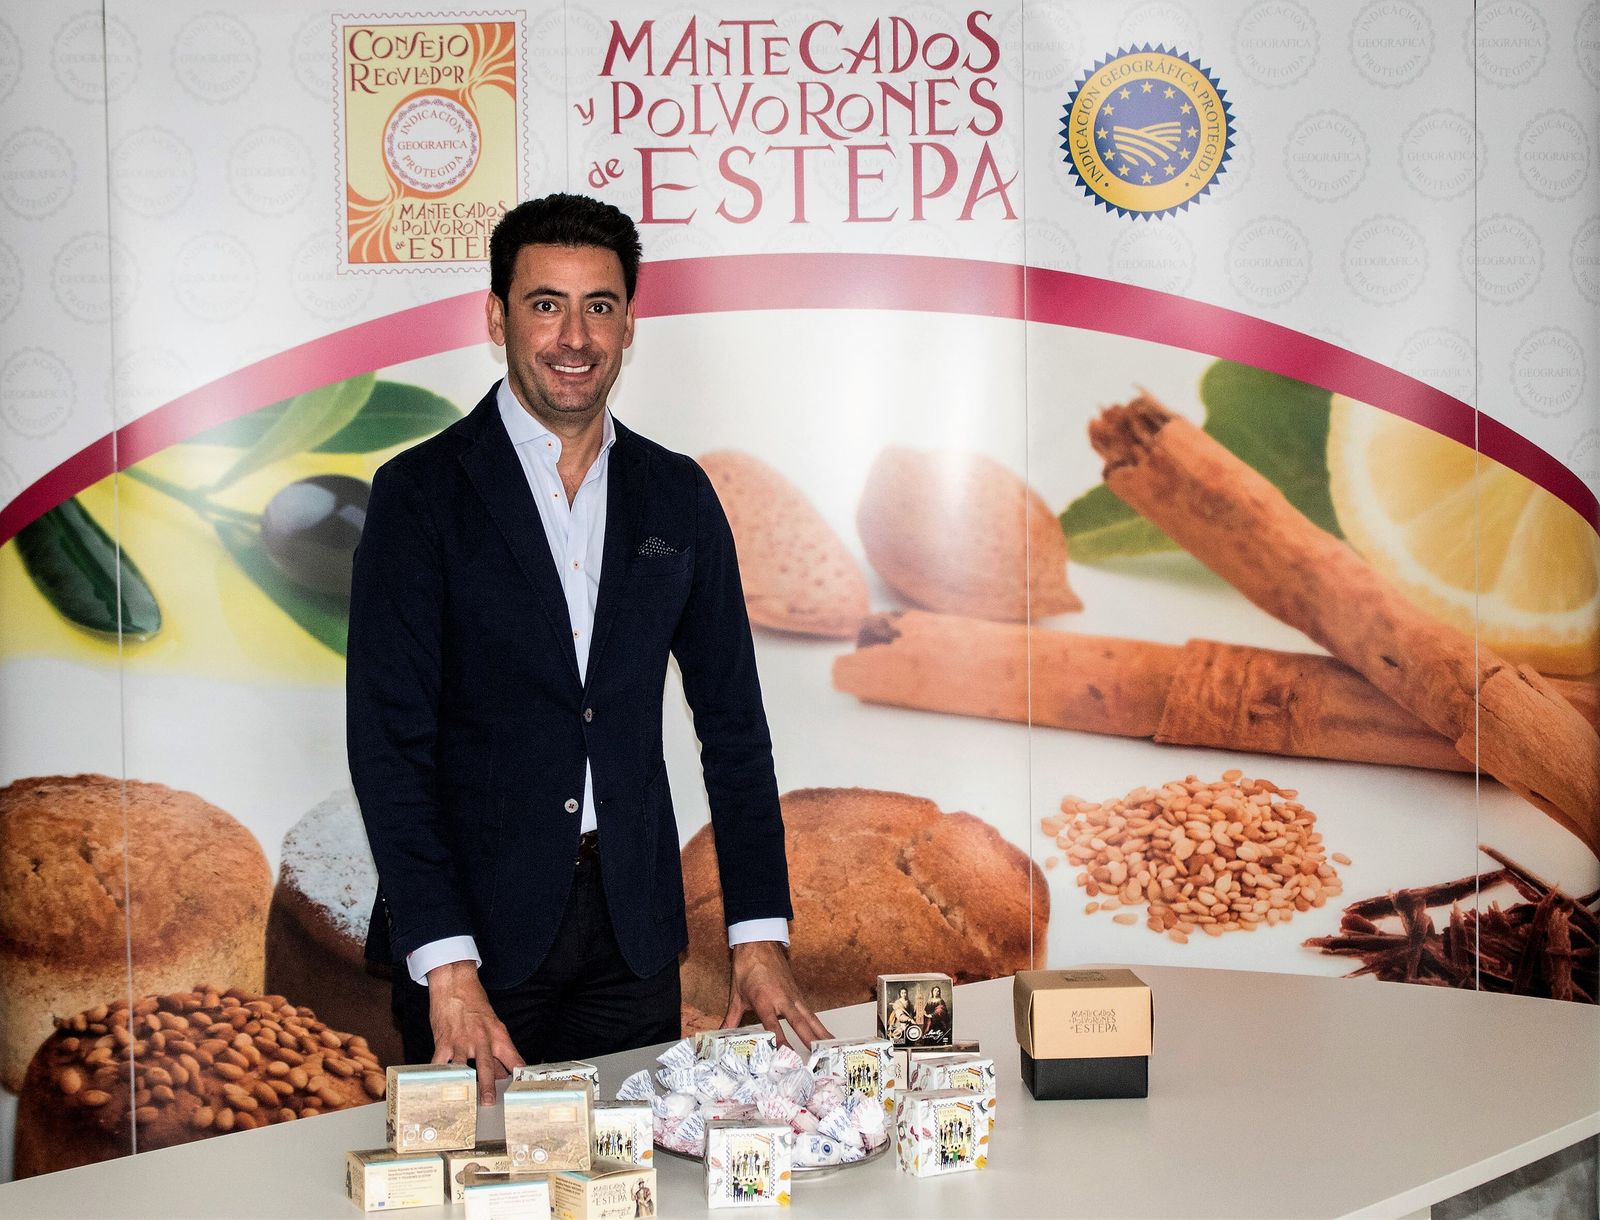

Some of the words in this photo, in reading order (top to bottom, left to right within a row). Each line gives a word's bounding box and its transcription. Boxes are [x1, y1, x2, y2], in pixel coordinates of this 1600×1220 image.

[597, 10, 1001, 77] MANTECADOS
[1240, 38, 1312, 49] GEOGRAFICA
[1357, 37, 1426, 48] GEOGRAFICA
[573, 97, 595, 126] y
[610, 76, 1004, 141] POLVORONES
[400, 109, 465, 136] INDICACION
[1076, 85, 1104, 184] INDICACIÓN
[1099, 57, 1199, 92] GEOGRÁFICA
[1190, 89, 1220, 182] PROTEGIDA
[397, 140, 468, 150] GEOGRAFICA
[1292, 151, 1362, 163] GEOGRAFICA
[1524, 151, 1586, 162] GEOGRAFICA
[402, 154, 463, 178] PROTEGIDA
[588, 155, 625, 189] de
[633, 141, 1020, 226] ESTEPA
[399, 200, 509, 220] MANTECADOS
[401, 219, 497, 236] POLVORONE
[409, 236, 491, 259] ESTE
[1233, 257, 1304, 268] GEOGRAFICA
[1350, 255, 1420, 266] GEOGRAFICA
[1518, 367, 1582, 378] GEOGRAFICA
[1075, 1023, 1118, 1033] ESTEPA
